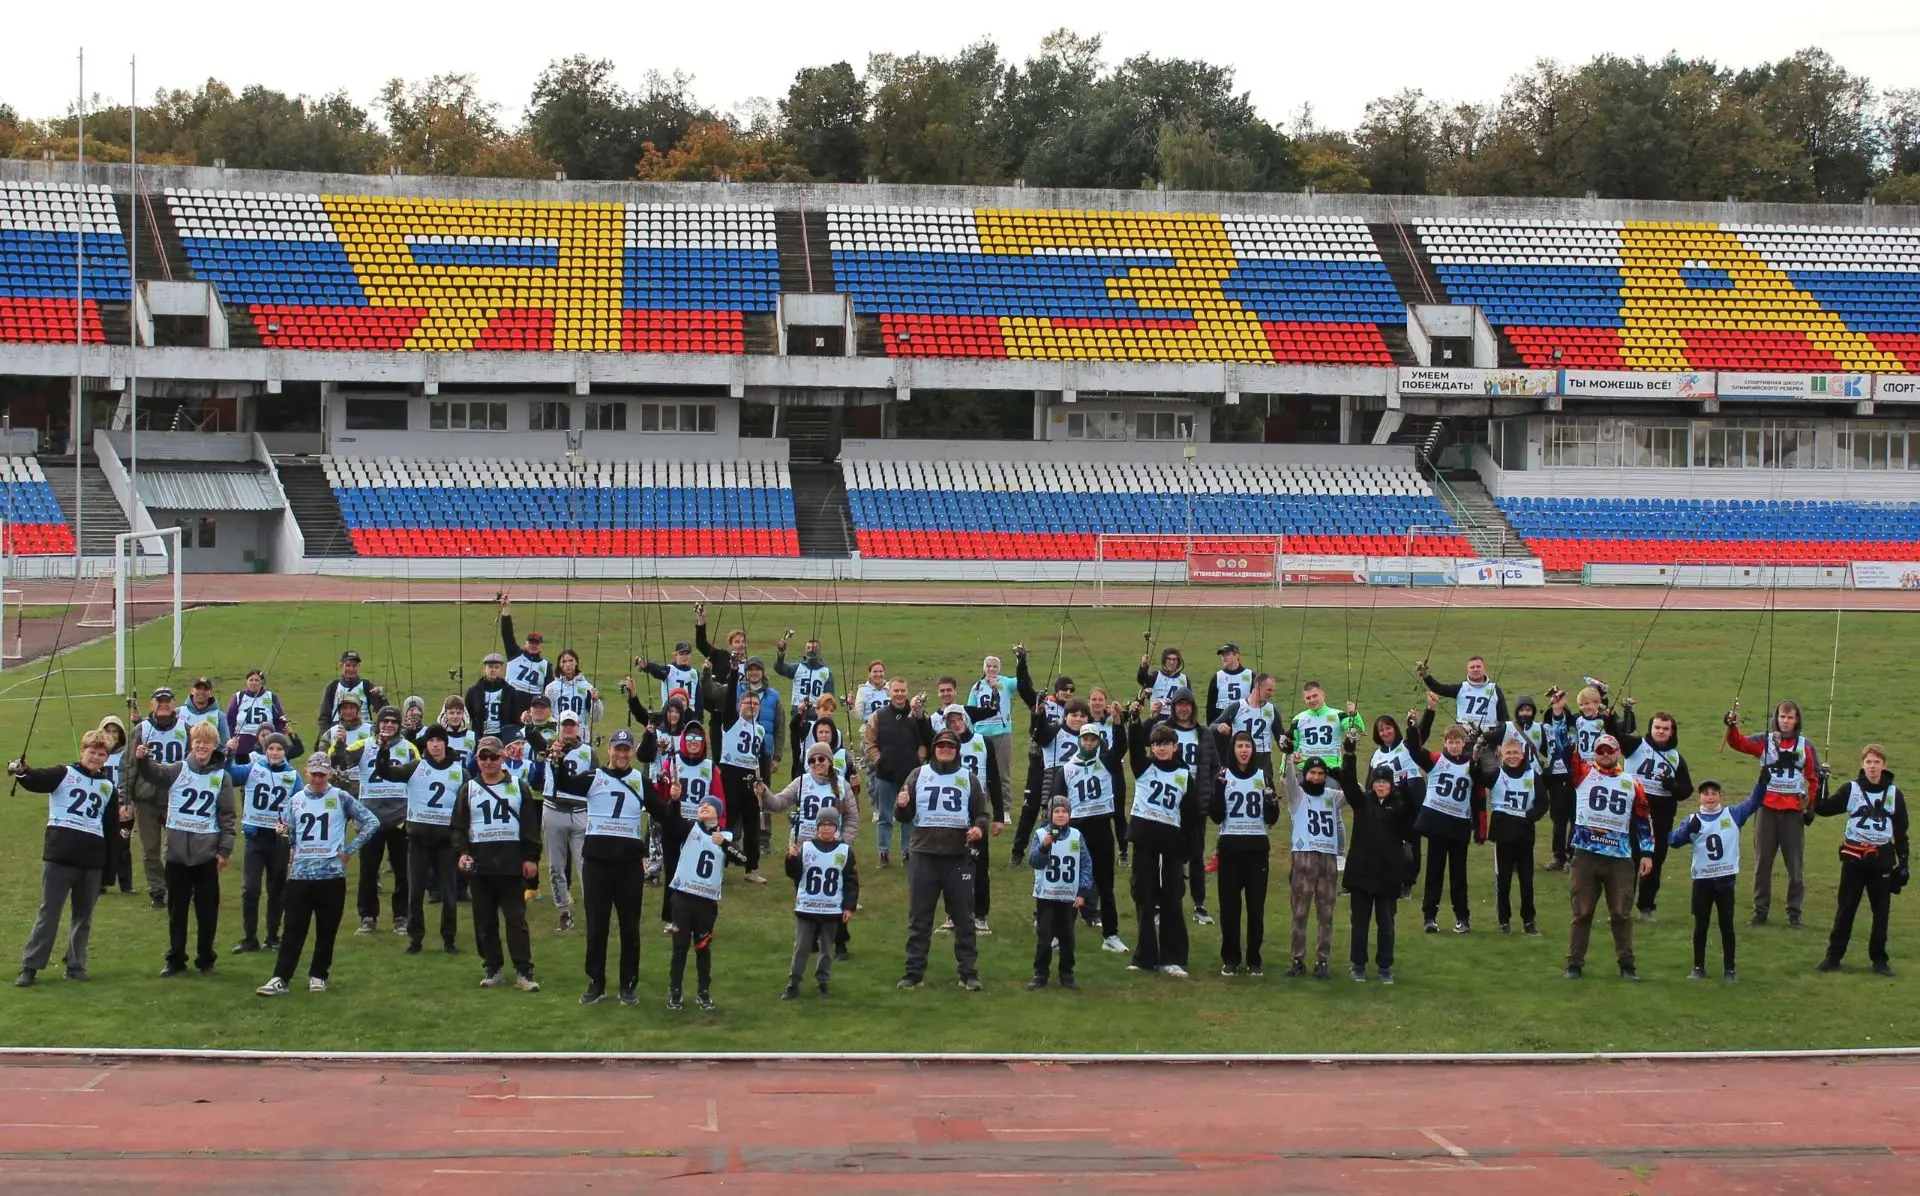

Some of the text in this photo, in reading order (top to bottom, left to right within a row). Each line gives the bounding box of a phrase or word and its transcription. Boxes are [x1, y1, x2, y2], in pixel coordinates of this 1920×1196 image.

[1402, 380, 1474, 390] ПОБЕЖДАТЬ!
[1411, 370, 1449, 380] УМЕЕМ
[1568, 378, 1672, 390] ТЫ МОЖЕШЬ ВСЁ!
[1883, 384, 1915, 393] СПОРТ
[517, 664, 540, 686] 74
[800, 678, 824, 698] 56
[1227, 683, 1241, 701] 5
[1465, 695, 1489, 716] 72
[243, 707, 268, 724] 15
[1243, 718, 1267, 740] 12
[1304, 725, 1333, 746] 53
[150, 741, 183, 763] 30
[252, 783, 288, 813] 62
[427, 781, 446, 809] 2
[923, 786, 963, 812] 73
[1073, 776, 1103, 802] 19
[1147, 780, 1178, 811] 25
[1435, 773, 1471, 803] 58
[1503, 790, 1530, 810] 57
[1588, 785, 1628, 816] 65
[66, 787, 103, 819] 23
[179, 787, 216, 818] 22
[476, 797, 512, 825] 14
[610, 791, 626, 819] 7
[1228, 791, 1262, 819] 28
[300, 812, 330, 842] 21
[1307, 809, 1334, 838] 35
[1590, 835, 1620, 846] GARMIN
[1705, 833, 1724, 862] 9
[695, 850, 716, 880] 6
[1045, 855, 1076, 884] 33
[805, 866, 840, 897] 68
